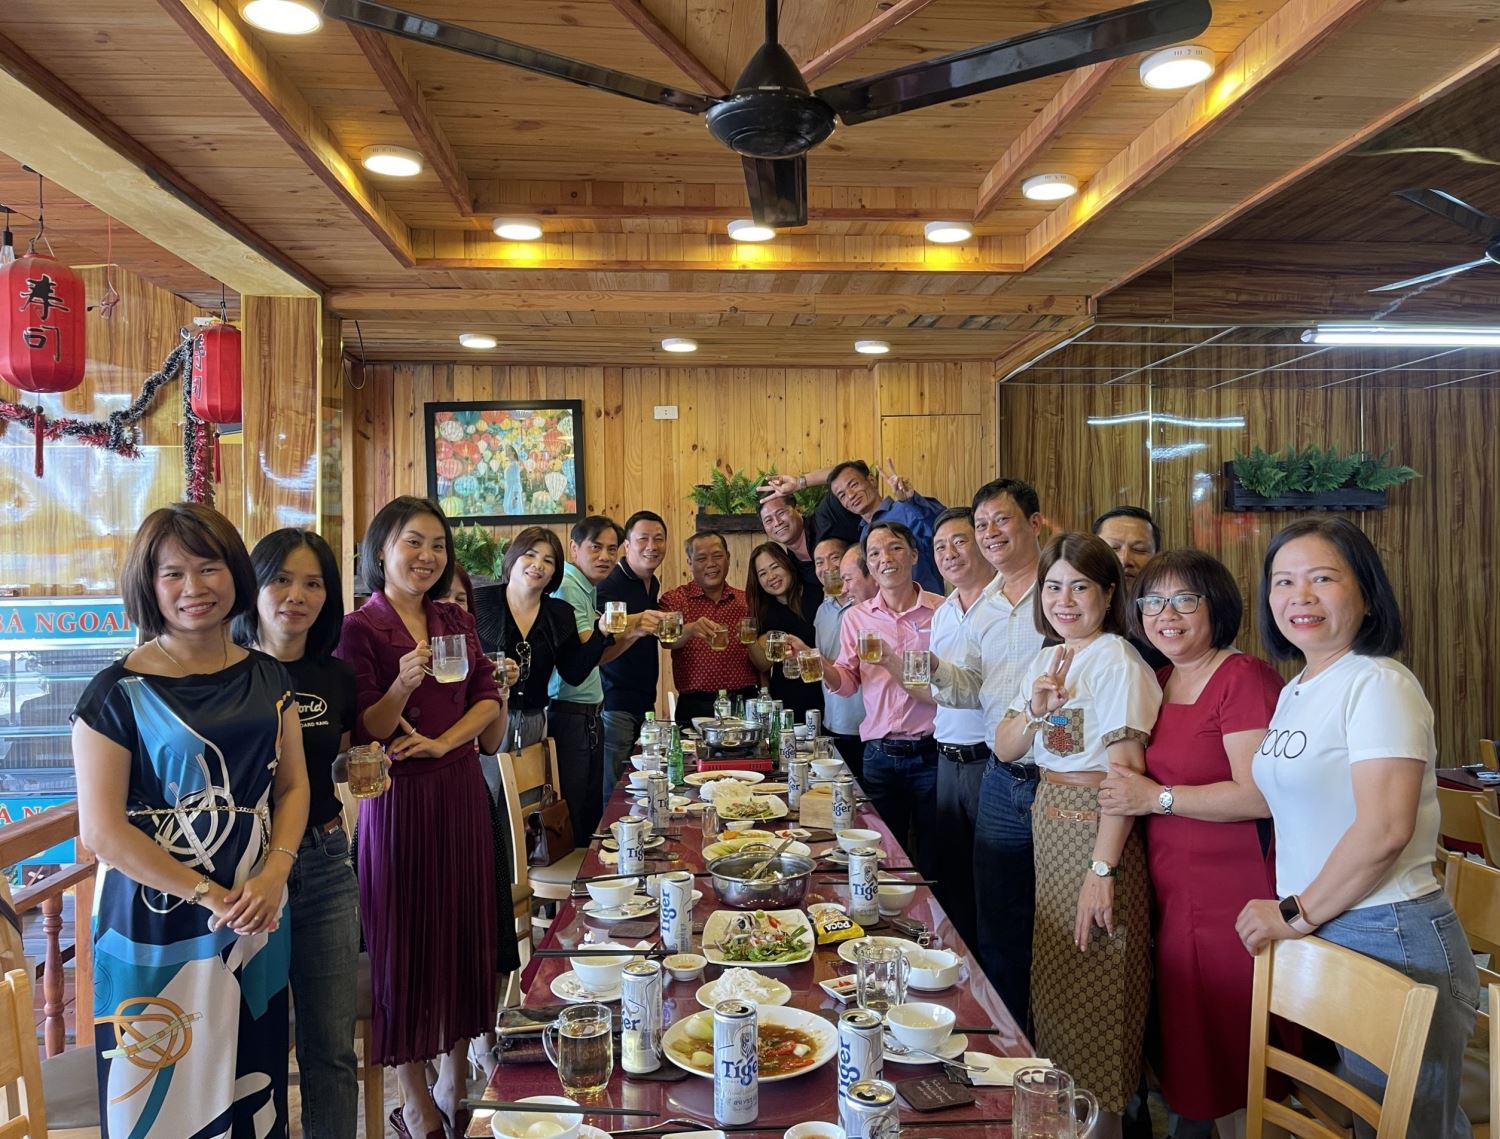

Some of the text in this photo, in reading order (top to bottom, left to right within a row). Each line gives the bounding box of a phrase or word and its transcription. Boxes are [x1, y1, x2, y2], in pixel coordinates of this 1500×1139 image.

[35, 611, 131, 635] NGOẠI
[297, 701, 322, 713] orld
[832, 802, 851, 816] iger
[627, 845, 644, 861] Tig
[853, 882, 878, 901] Tige
[661, 888, 677, 933] Tiger
[825, 921, 852, 931] POCA
[721, 1055, 757, 1086] Tige
